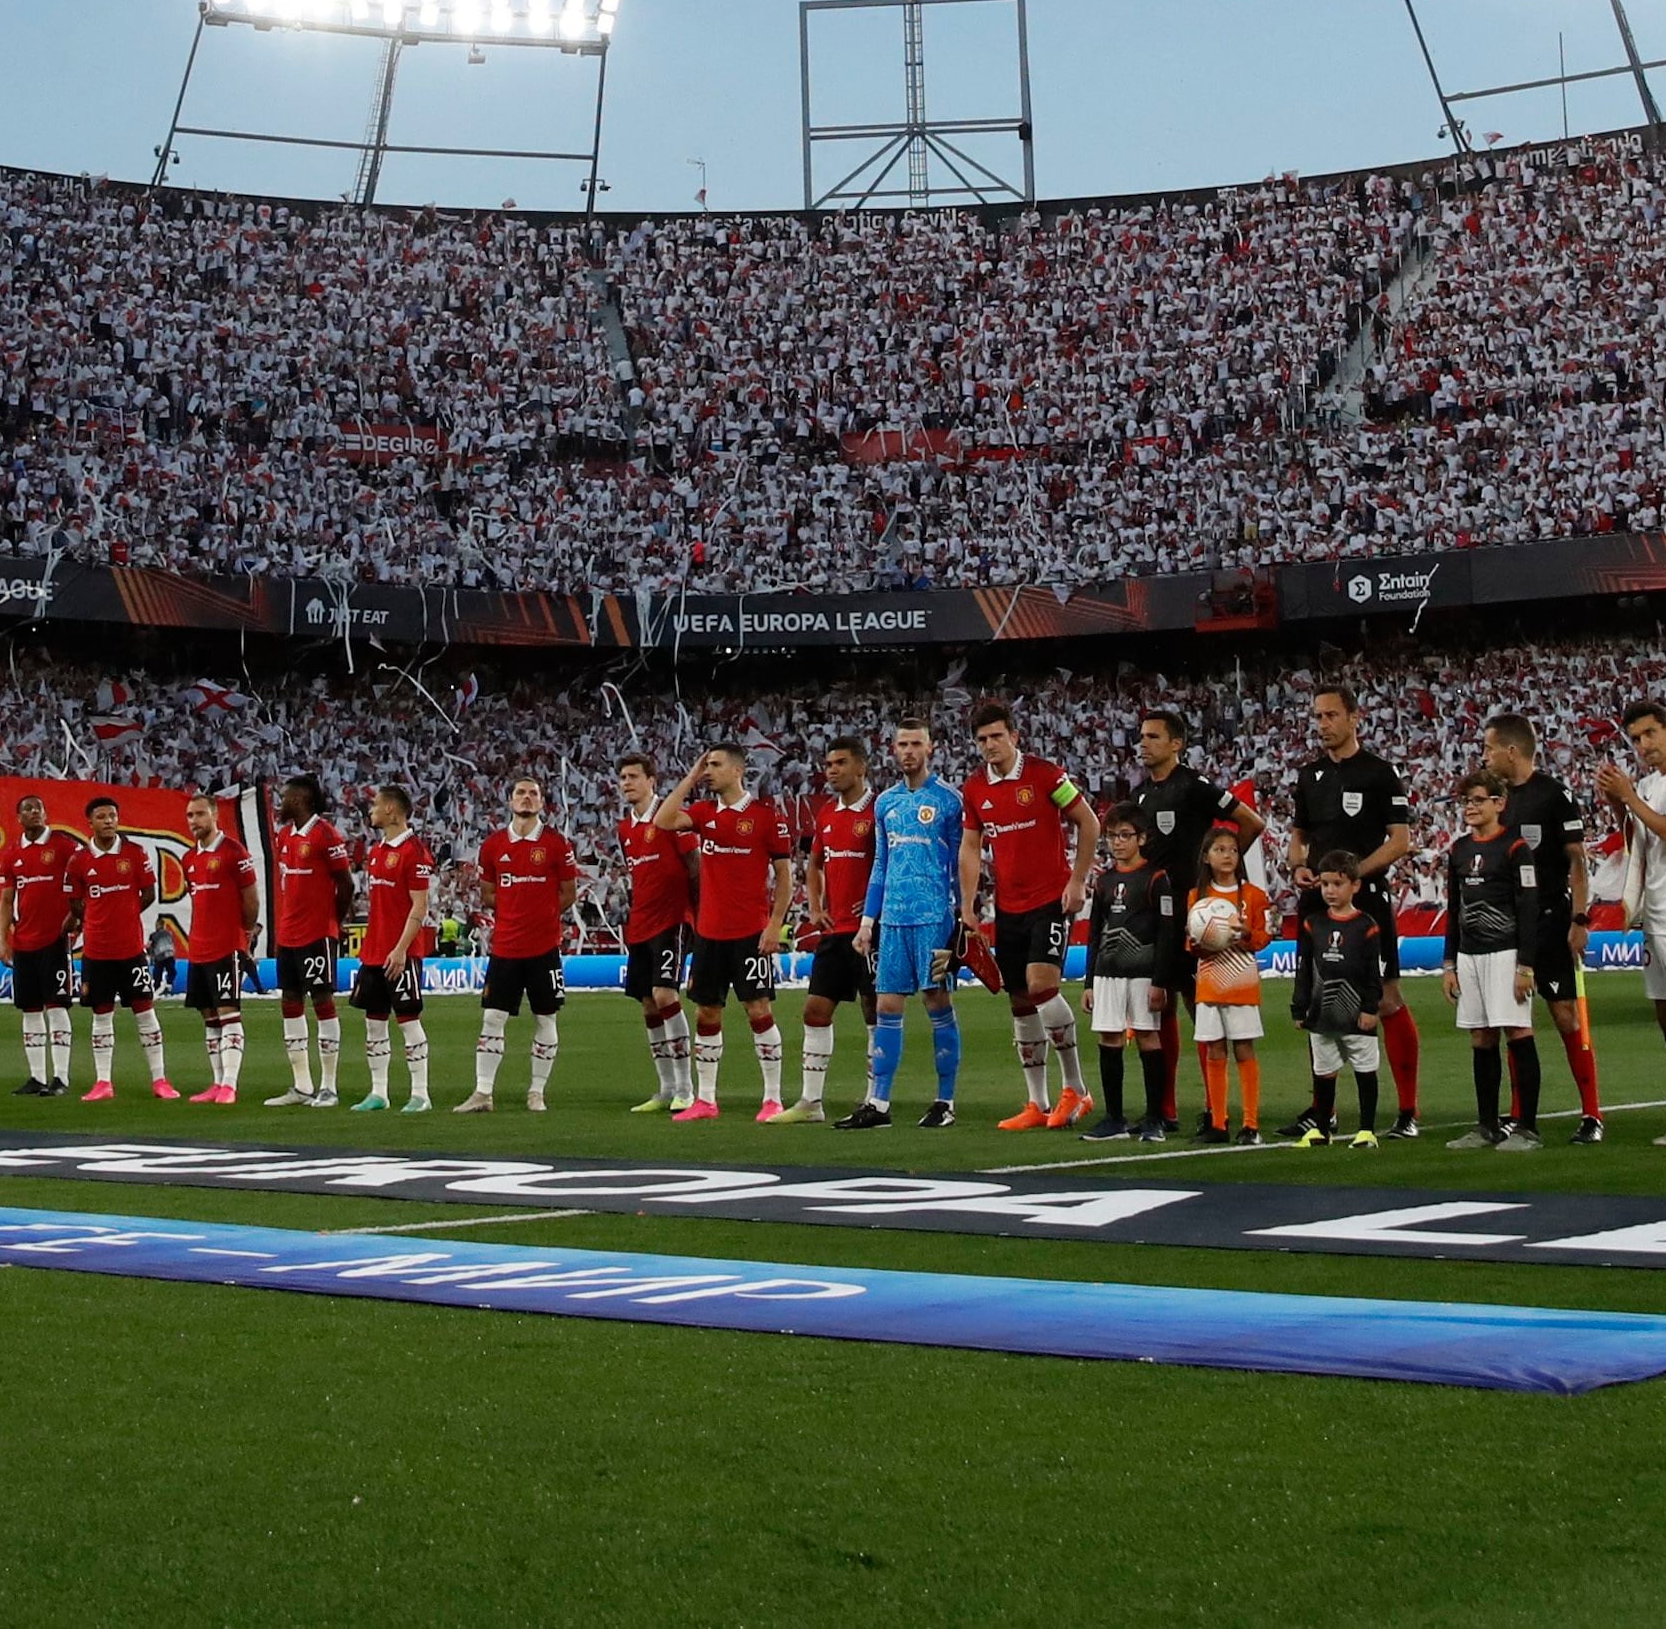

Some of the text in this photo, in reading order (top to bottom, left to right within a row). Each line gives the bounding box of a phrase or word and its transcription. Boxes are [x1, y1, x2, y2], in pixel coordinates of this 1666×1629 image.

[1378, 588, 1431, 601] Foundation
[362, 609, 389, 624] EAT
[673, 610, 927, 633] UEFA EUROPA LEAGUE
[1049, 923, 1063, 946] 5
[304, 956, 325, 979] 29
[661, 950, 674, 971] 2
[745, 957, 767, 980] 20
[56, 970, 66, 987] 9
[132, 966, 151, 987] 25
[217, 972, 232, 990] 14
[395, 971, 411, 992] 21
[549, 969, 564, 991] 15
